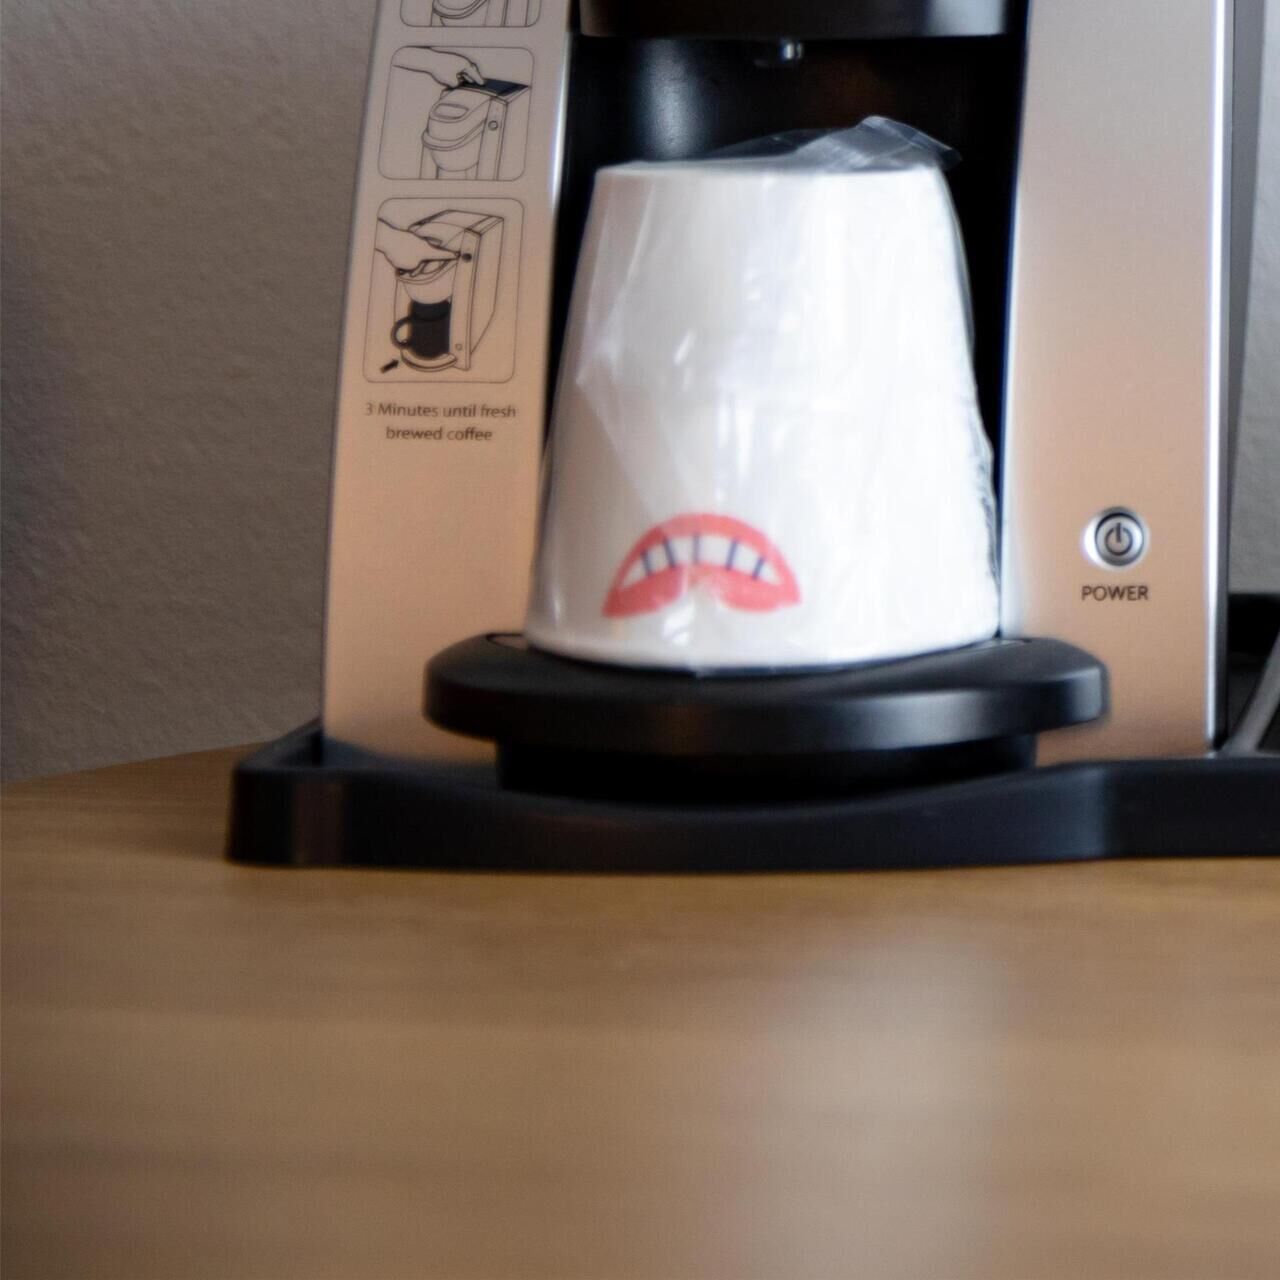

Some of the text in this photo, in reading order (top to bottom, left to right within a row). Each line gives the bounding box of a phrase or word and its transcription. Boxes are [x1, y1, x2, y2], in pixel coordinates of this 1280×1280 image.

[365, 402, 517, 418] 3 Minutes until fresh
[386, 426, 493, 441] brewed coffee
[1081, 585, 1149, 601] POWER
